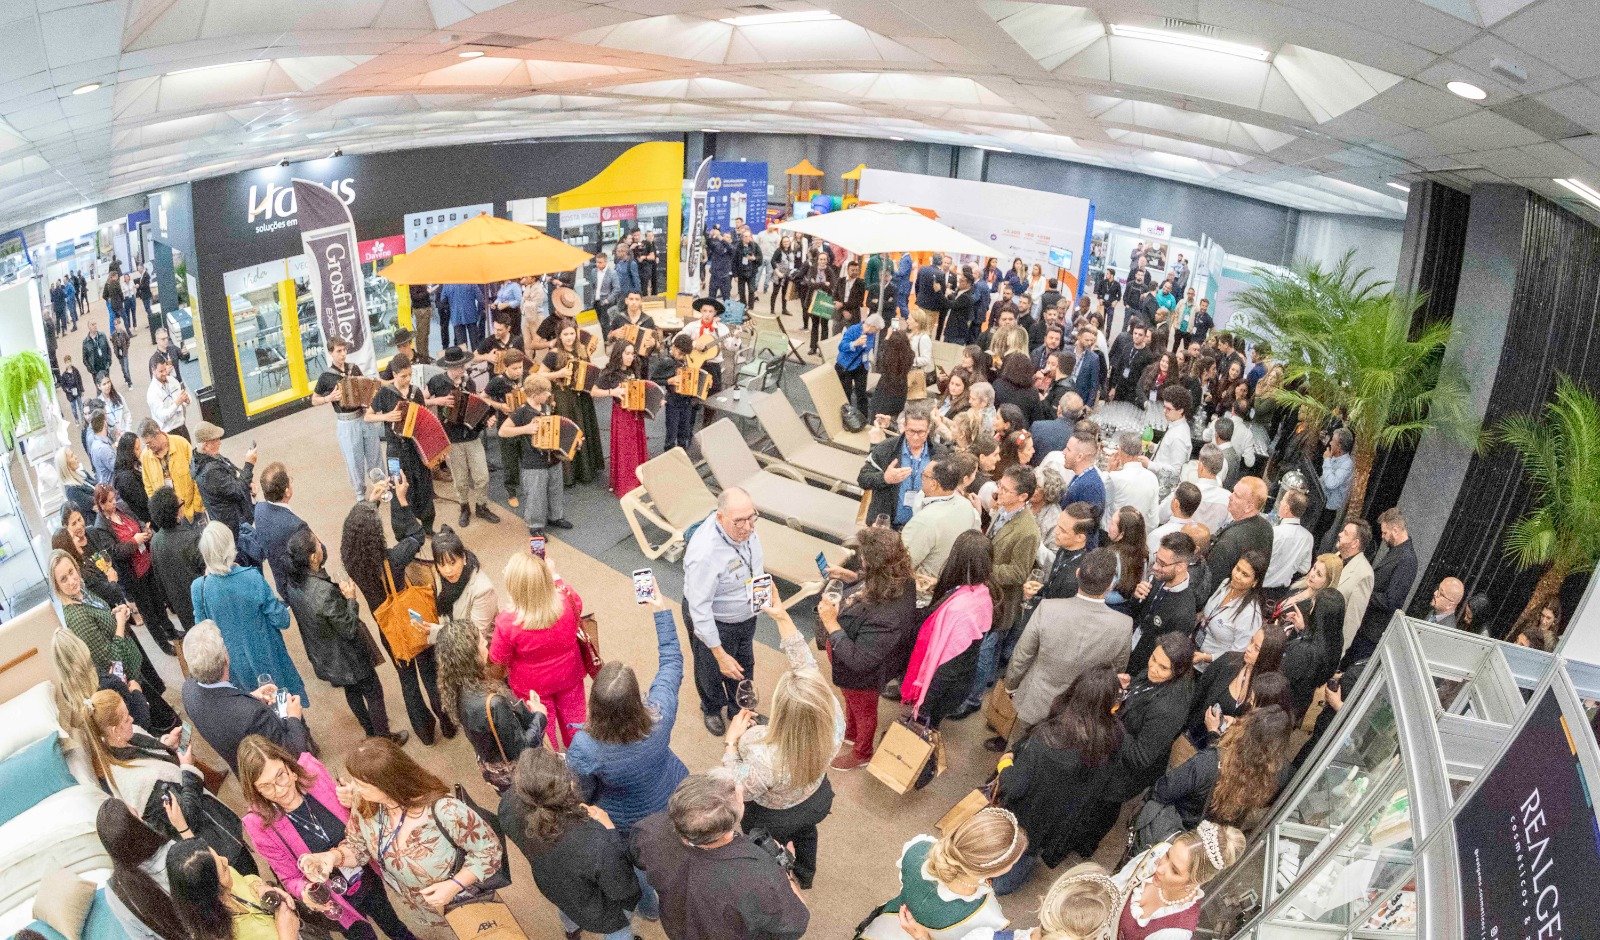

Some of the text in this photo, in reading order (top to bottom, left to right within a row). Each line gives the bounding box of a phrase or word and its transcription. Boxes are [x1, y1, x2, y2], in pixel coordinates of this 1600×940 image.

[255, 218, 298, 233] soluções em
[325, 242, 356, 348] Grosfillex
[1520, 787, 1563, 940] REALGE
